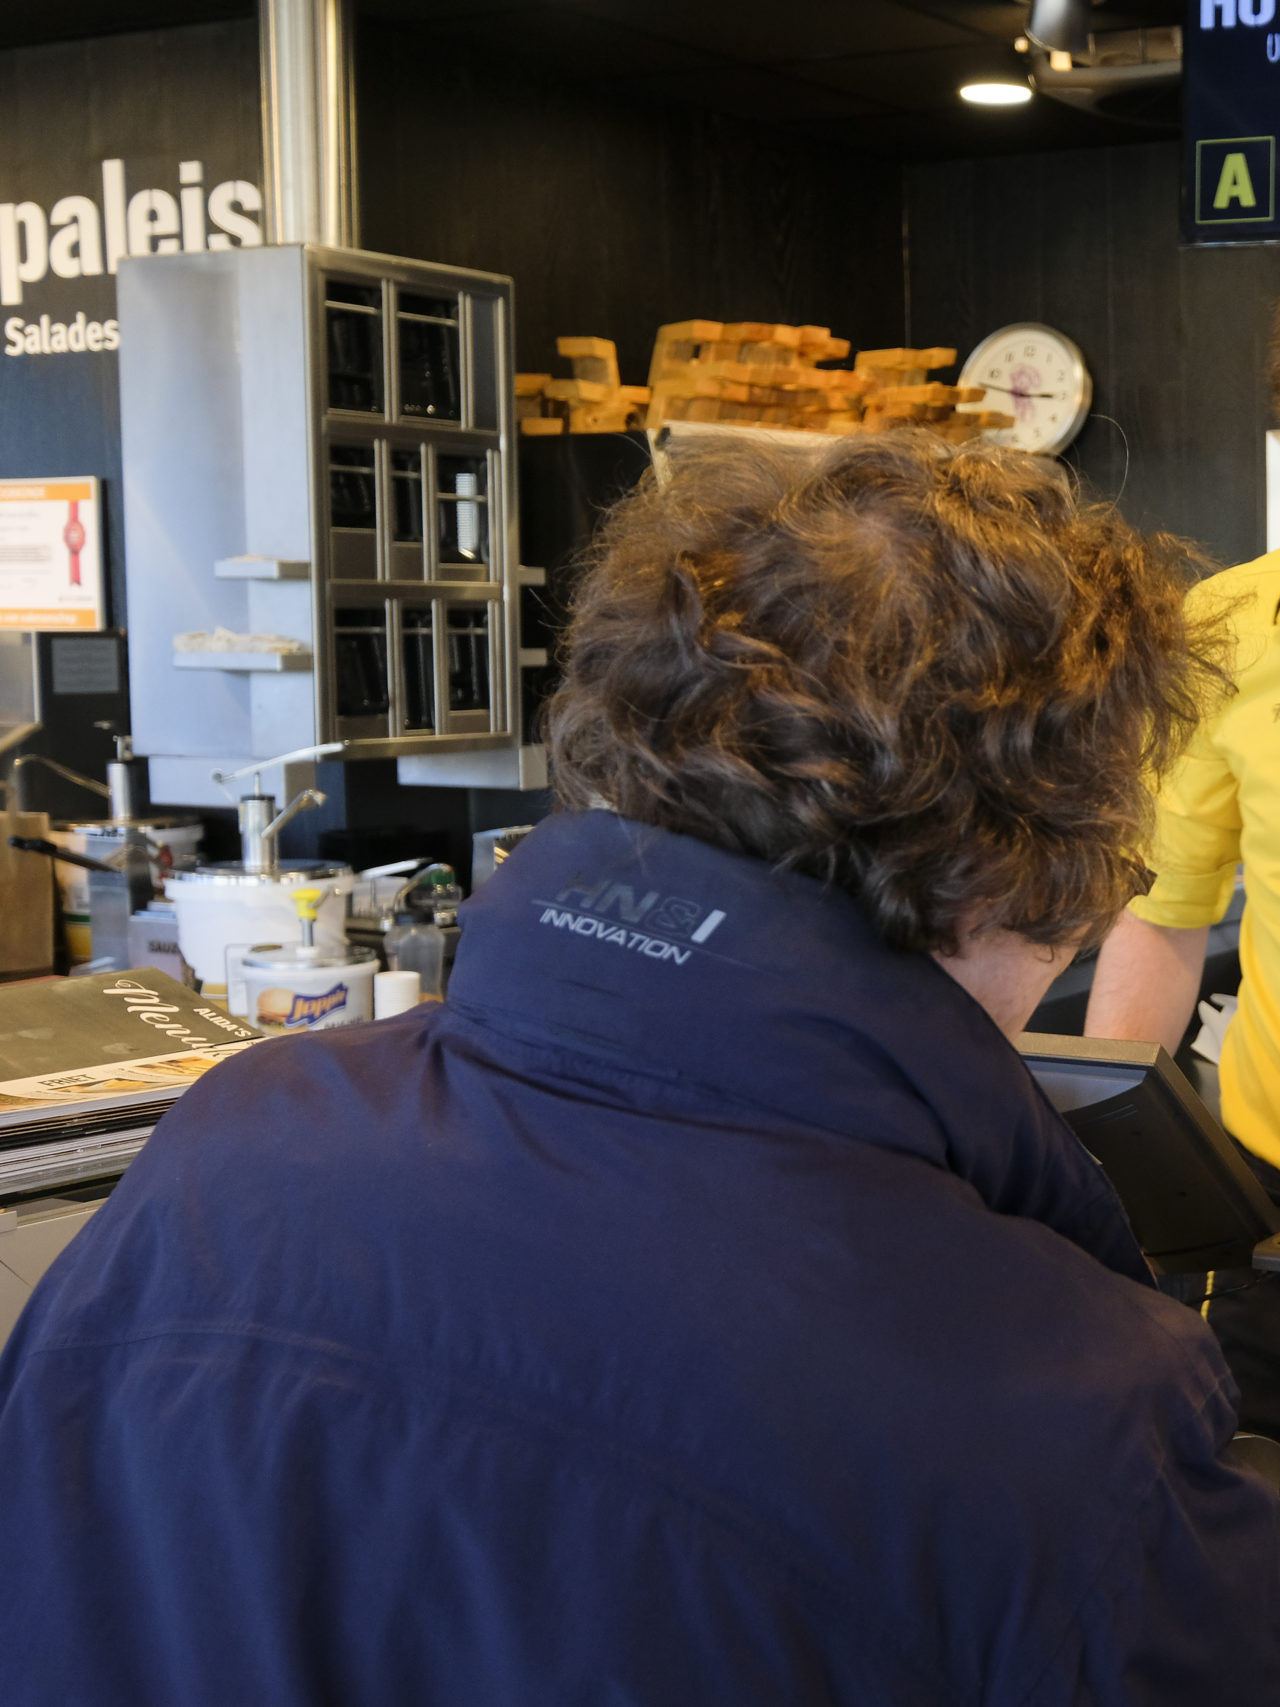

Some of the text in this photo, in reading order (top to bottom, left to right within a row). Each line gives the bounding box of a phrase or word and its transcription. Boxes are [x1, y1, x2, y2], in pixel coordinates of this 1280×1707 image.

[1213, 152, 1256, 209] A
[0, 158, 264, 306] paleis
[4, 311, 121, 357] Salades
[539, 907, 693, 966] INNOVATION
[193, 1007, 252, 1038] ALIDA'S
